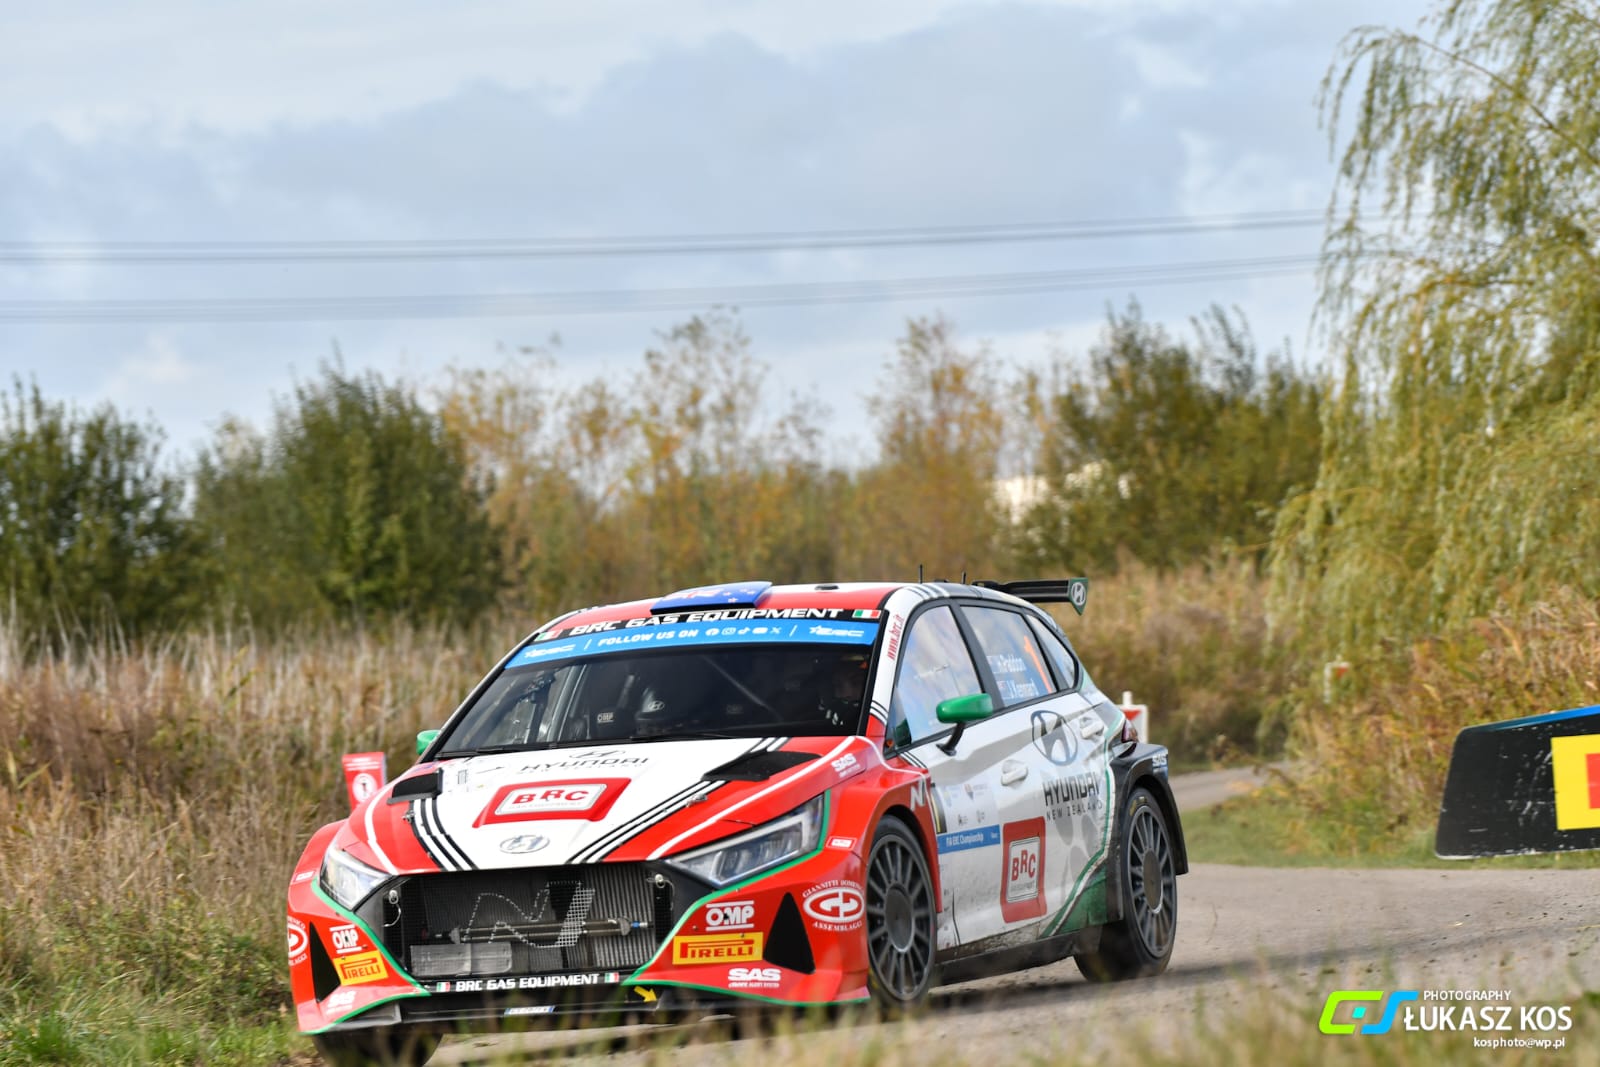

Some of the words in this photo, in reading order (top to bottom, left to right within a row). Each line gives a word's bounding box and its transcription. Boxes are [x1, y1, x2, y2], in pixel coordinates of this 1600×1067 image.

[568, 620, 622, 637] BRC
[625, 614, 680, 628] GAS
[686, 608, 844, 622] EQUIPMENT
[597, 635, 653, 647] FOLLOW
[656, 631, 675, 641] US
[678, 630, 700, 638] ON
[520, 757, 649, 771] HYUNDAI
[512, 789, 589, 804] BRC
[1042, 771, 1100, 807] HYUNDAI
[1046, 807, 1063, 821] NEW
[1067, 799, 1103, 817] ZEALAND
[1011, 849, 1036, 881] BRC
[705, 905, 755, 926] OMP
[332, 929, 359, 949] OMP
[680, 939, 754, 959] PIRELLI
[339, 957, 381, 980] PIRELLI
[727, 968, 782, 981] SAS
[455, 980, 483, 992] BRC
[486, 978, 516, 991] GAS
[519, 973, 601, 989] EQUIPMENT
